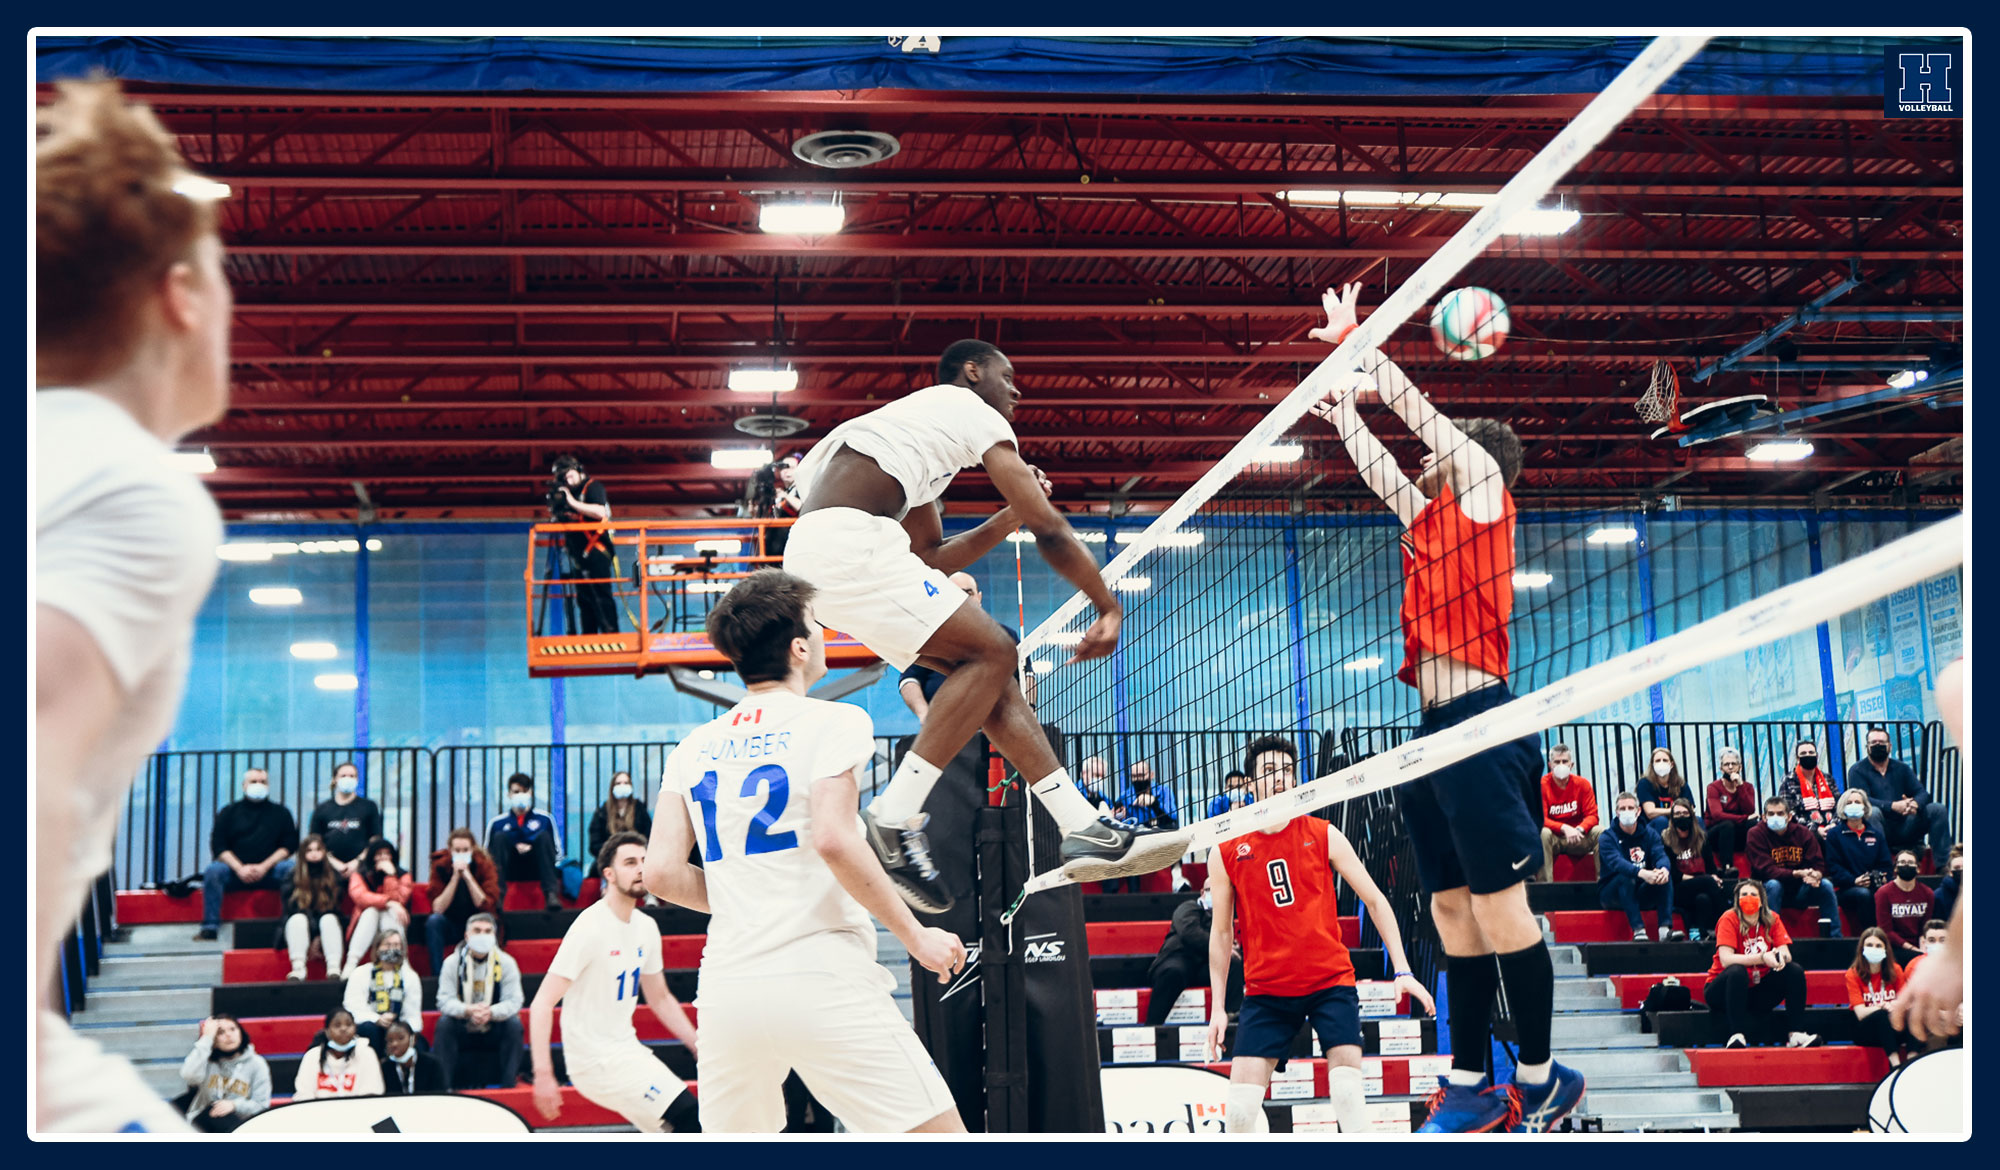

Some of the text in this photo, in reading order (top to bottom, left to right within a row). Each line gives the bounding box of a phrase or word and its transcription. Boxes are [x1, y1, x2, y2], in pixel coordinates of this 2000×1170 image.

[924, 580, 939, 597] 4
[1891, 586, 1916, 606] RSEQ
[1924, 575, 1958, 601] RSEQ
[696, 731, 791, 763] HUMBER
[690, 764, 799, 863] 12
[1549, 801, 1578, 815] ROYALS
[1266, 858, 1295, 908] 9
[616, 966, 641, 1001] 11
